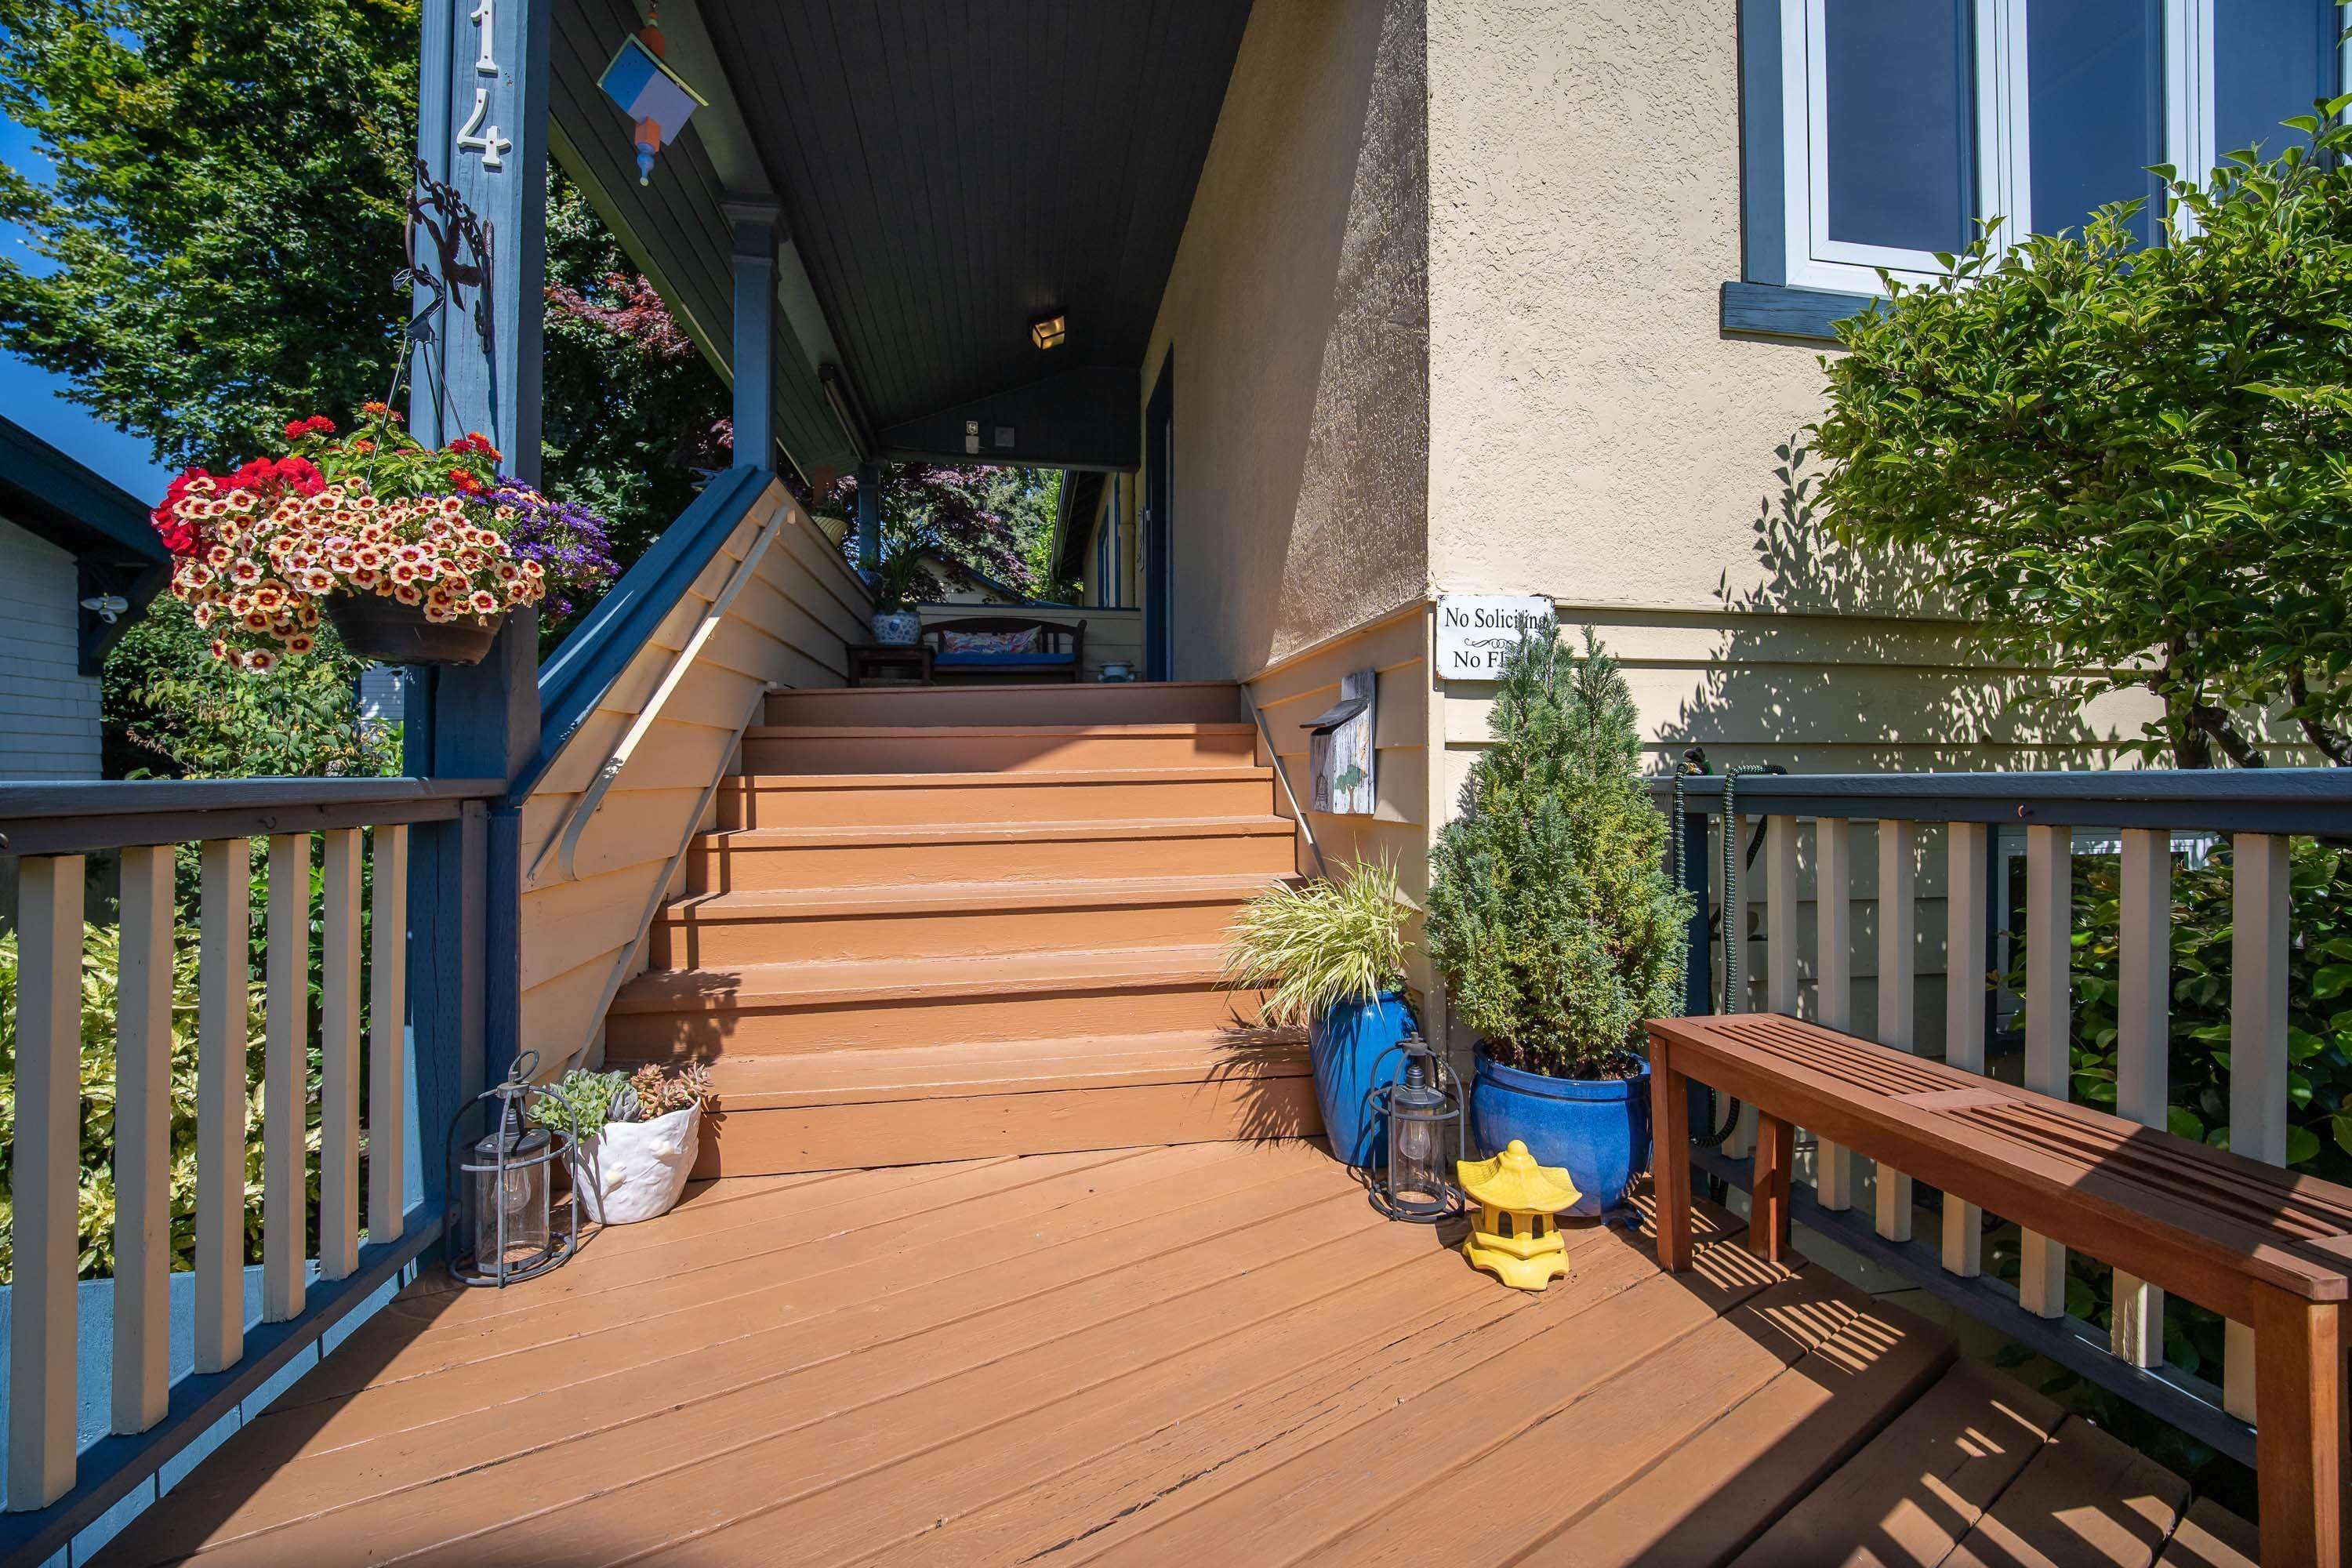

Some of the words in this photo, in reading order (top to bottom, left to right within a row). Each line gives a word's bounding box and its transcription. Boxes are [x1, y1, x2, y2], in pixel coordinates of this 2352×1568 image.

[1444, 607, 1469, 628] No
[1475, 608, 1548, 631] Soliciin
[1453, 651, 1481, 668] No
